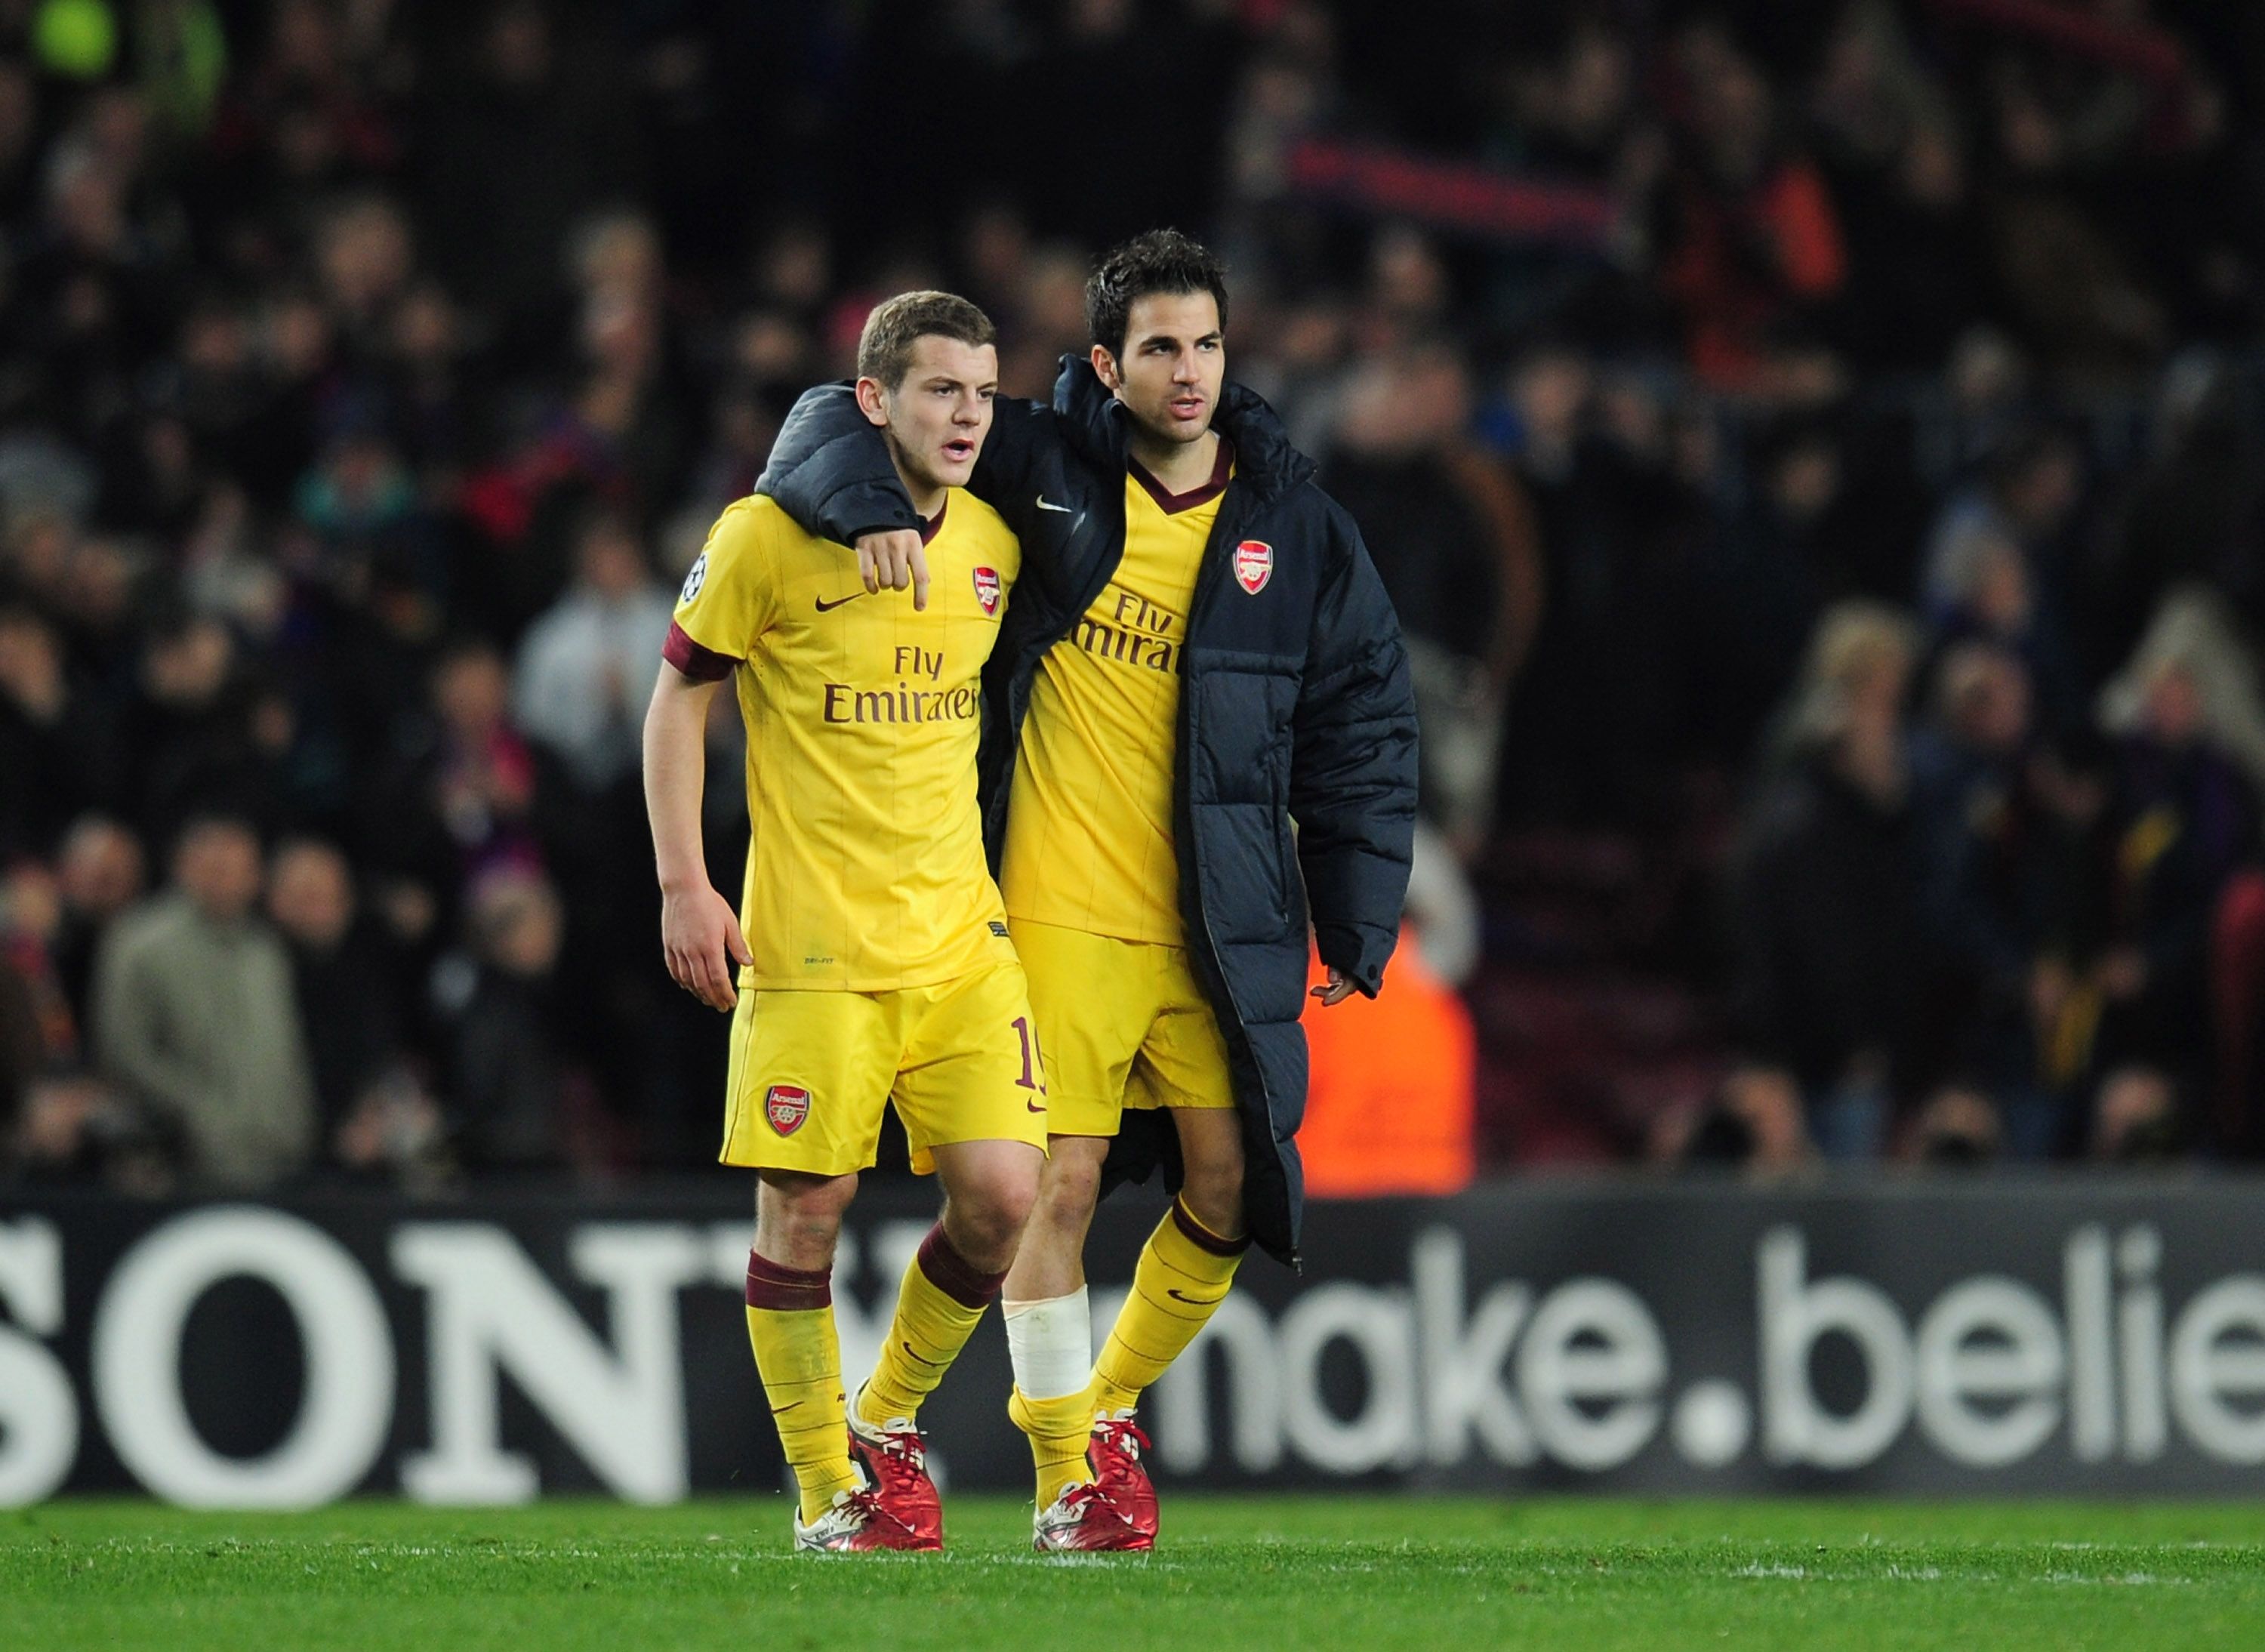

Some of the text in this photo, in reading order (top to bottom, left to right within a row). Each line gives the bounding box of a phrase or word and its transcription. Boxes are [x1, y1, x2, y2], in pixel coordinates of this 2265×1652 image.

[894, 646, 943, 681] Fly
[1059, 619, 1183, 674] mira
[1011, 1016, 1046, 1096] 1
